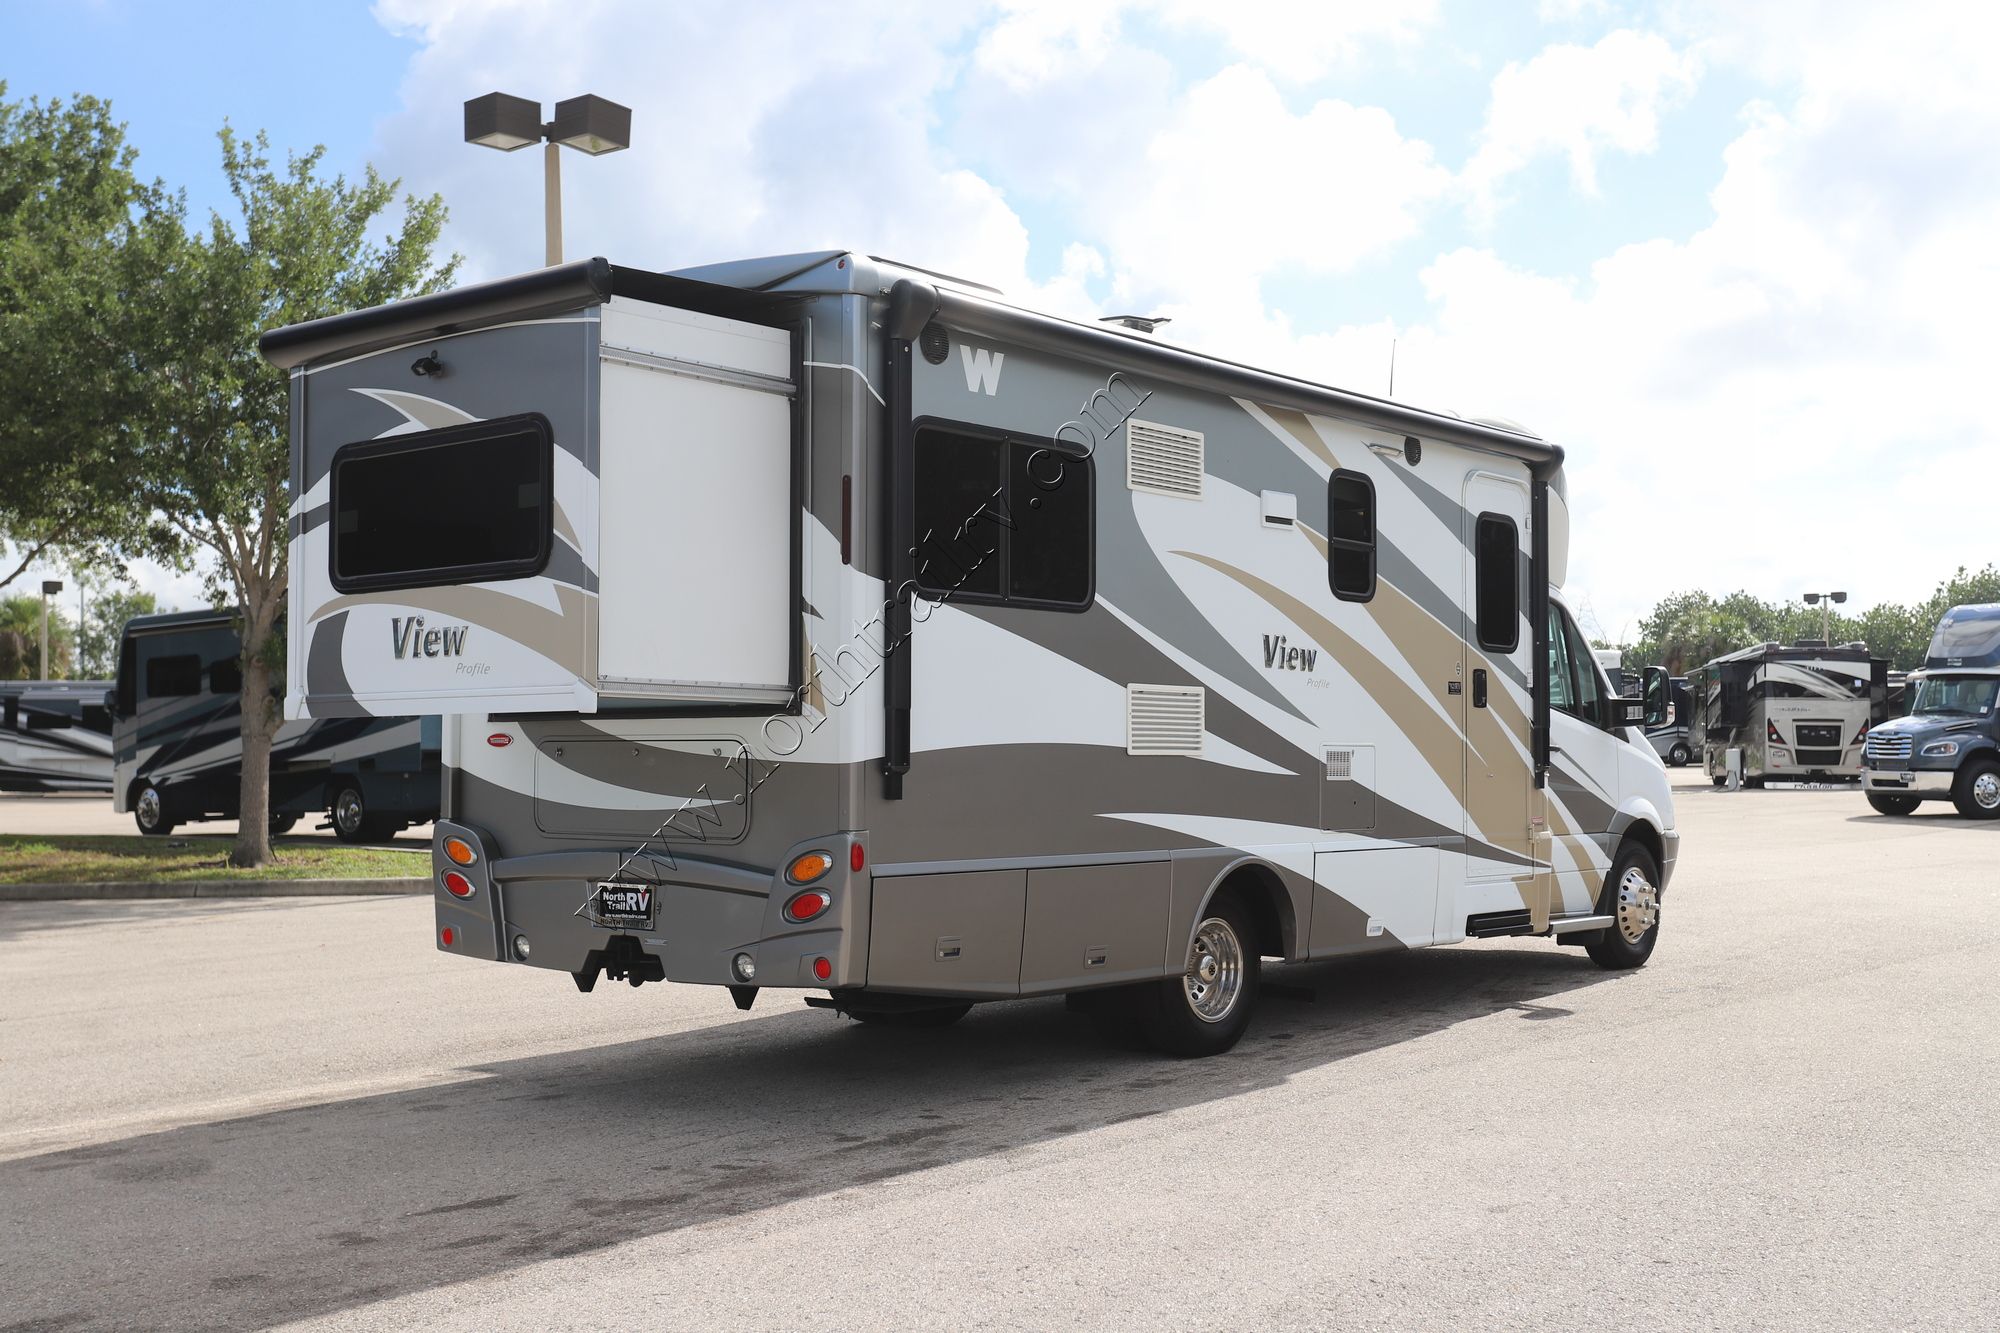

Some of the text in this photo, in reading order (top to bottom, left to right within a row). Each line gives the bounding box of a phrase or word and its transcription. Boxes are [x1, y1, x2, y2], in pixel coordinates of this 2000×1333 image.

[960, 344, 1004, 396] W
[391, 615, 469, 660] View
[1262, 633, 1317, 672] View
[456, 663, 491, 676] Profile
[1306, 678, 1330, 688] Profile
[603, 892, 625, 901] North
[626, 892, 650, 912] RV
[607, 901, 625, 910] Trail
